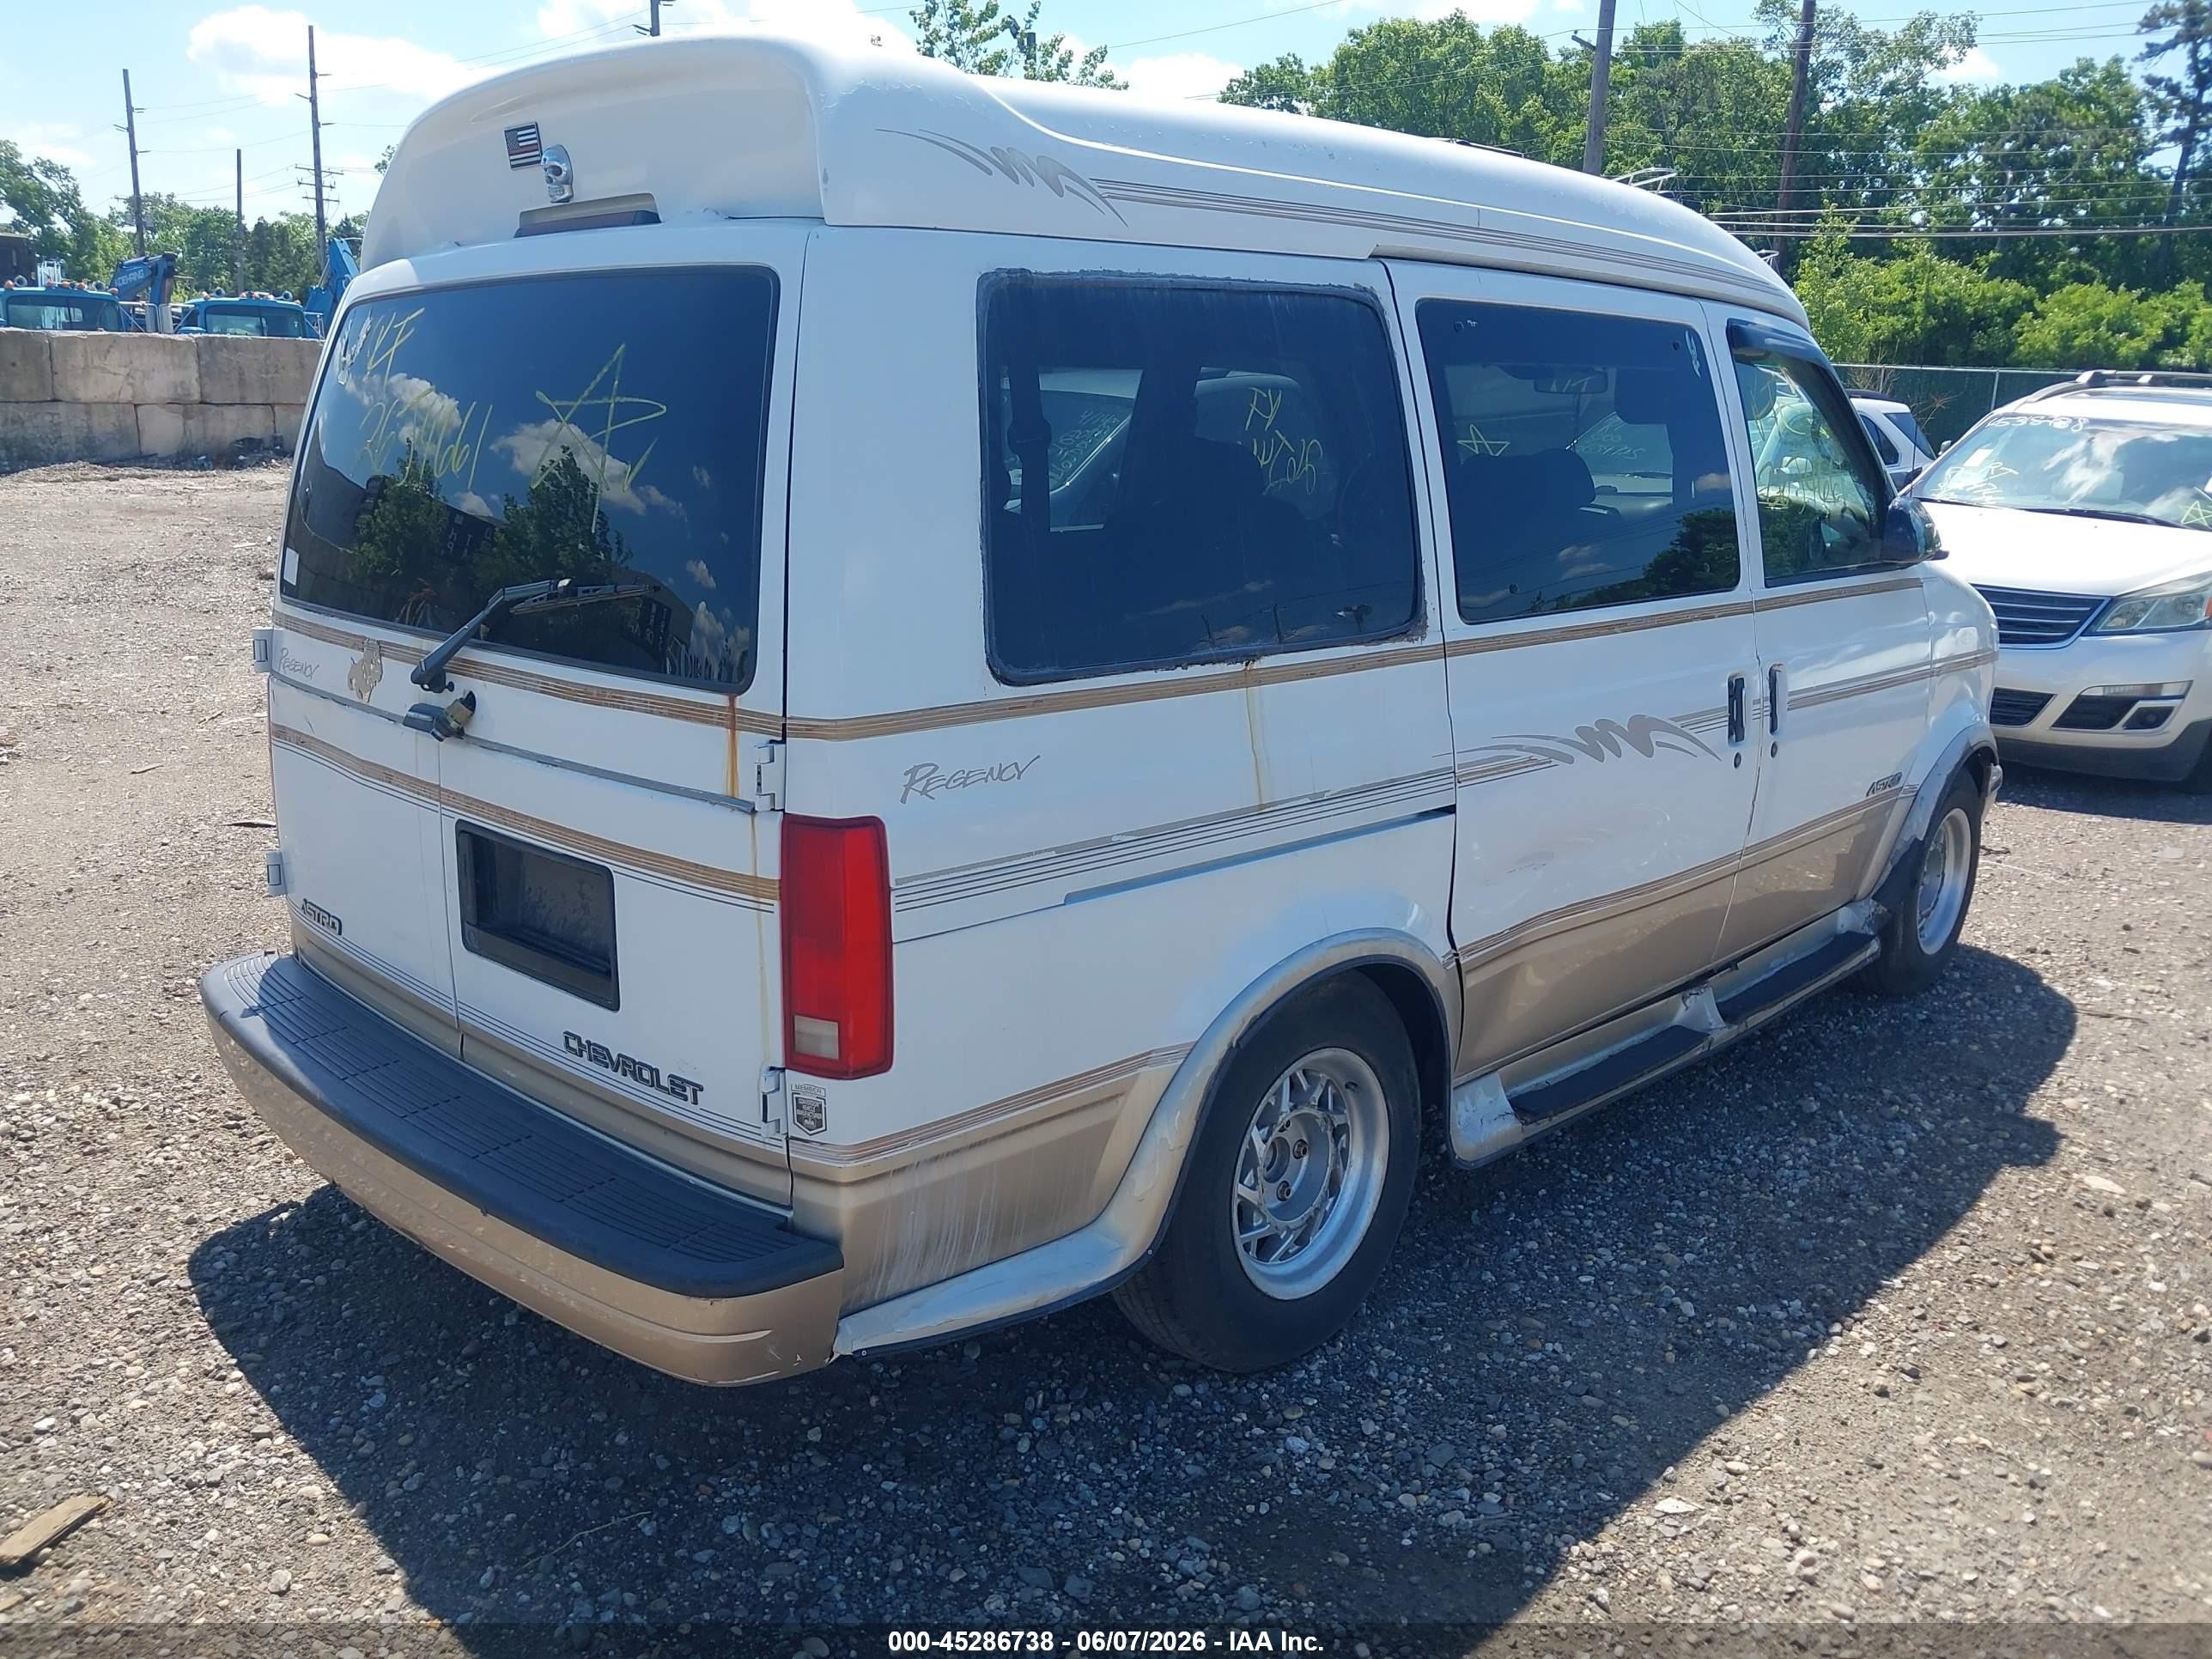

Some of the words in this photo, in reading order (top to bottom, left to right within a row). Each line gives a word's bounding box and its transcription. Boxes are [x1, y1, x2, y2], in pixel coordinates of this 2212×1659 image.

[900, 754, 1041, 805] REGENCY
[301, 897, 343, 936] ASTRO
[563, 1030, 704, 1106] CHEVROLET
[794, 1084, 823, 1094] MEMBER
